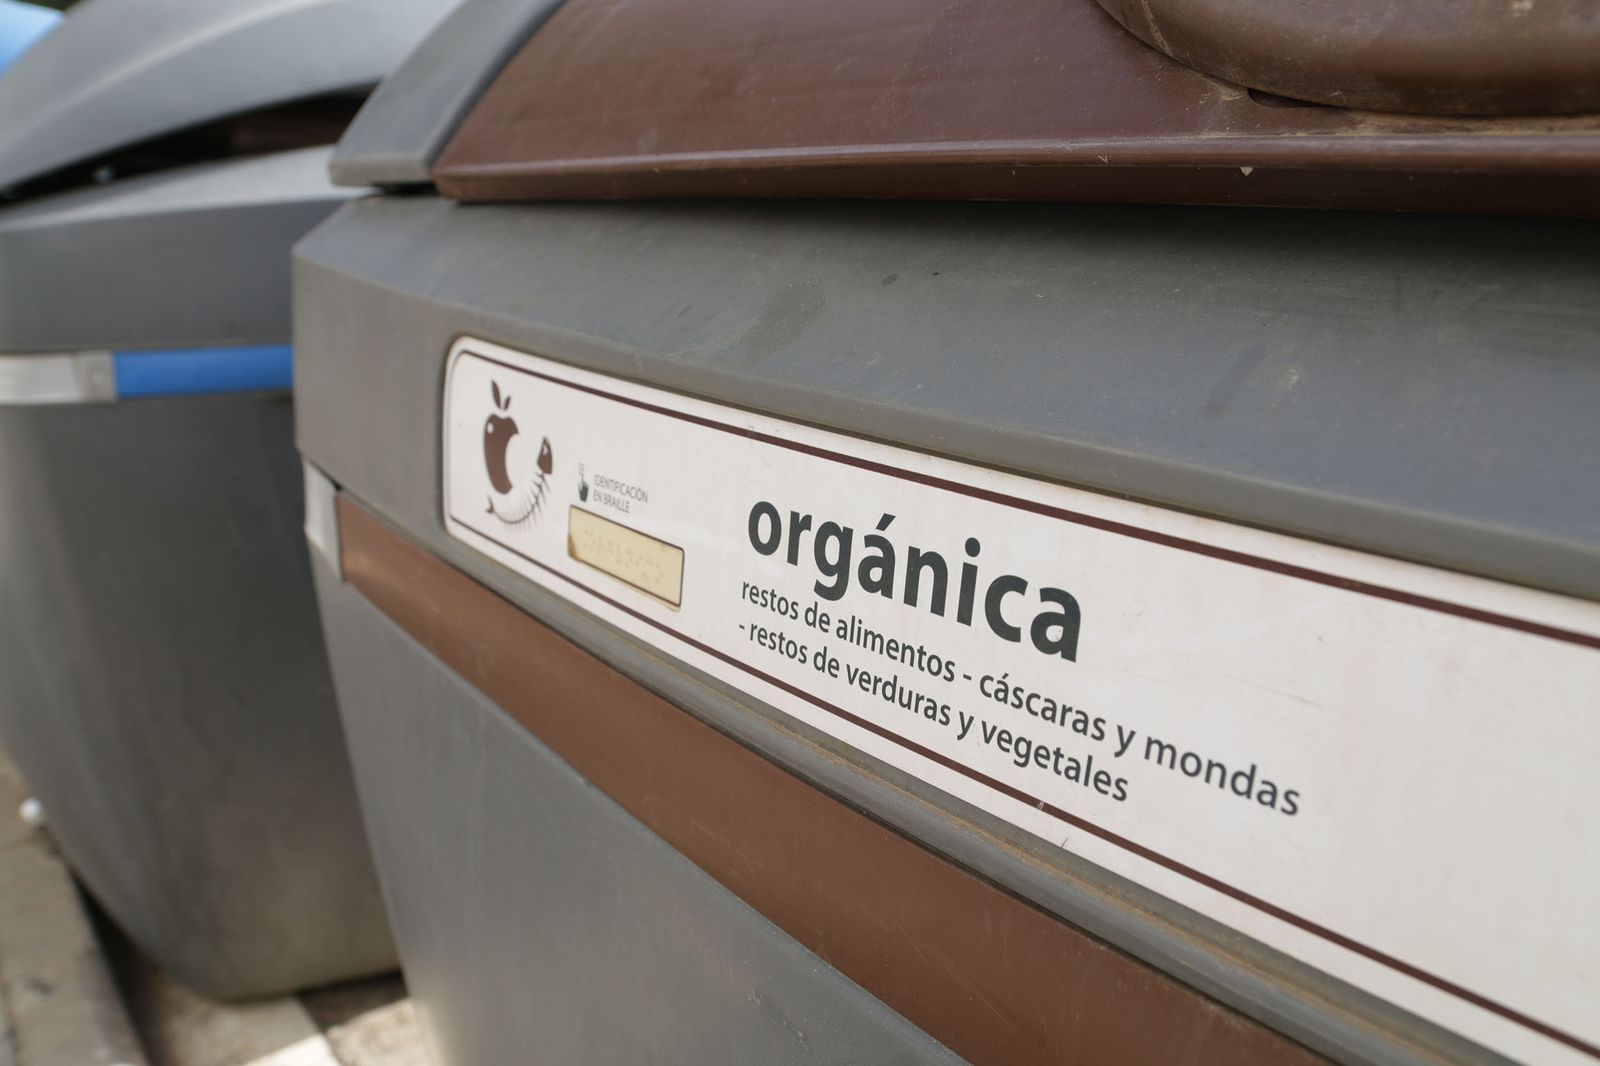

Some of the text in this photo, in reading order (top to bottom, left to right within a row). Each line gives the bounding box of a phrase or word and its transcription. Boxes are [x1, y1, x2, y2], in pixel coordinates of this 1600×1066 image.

[593, 489, 630, 514] EN BRAILLE
[748, 500, 1082, 663] orgánica
[742, 581, 1300, 816] restos de alimentos - cáscaras y mondas
[749, 623, 808, 665] restos
[813, 645, 840, 679] de
[846, 663, 952, 727] verduras
[956, 710, 975, 741] y
[981, 719, 1129, 802] vegetales
